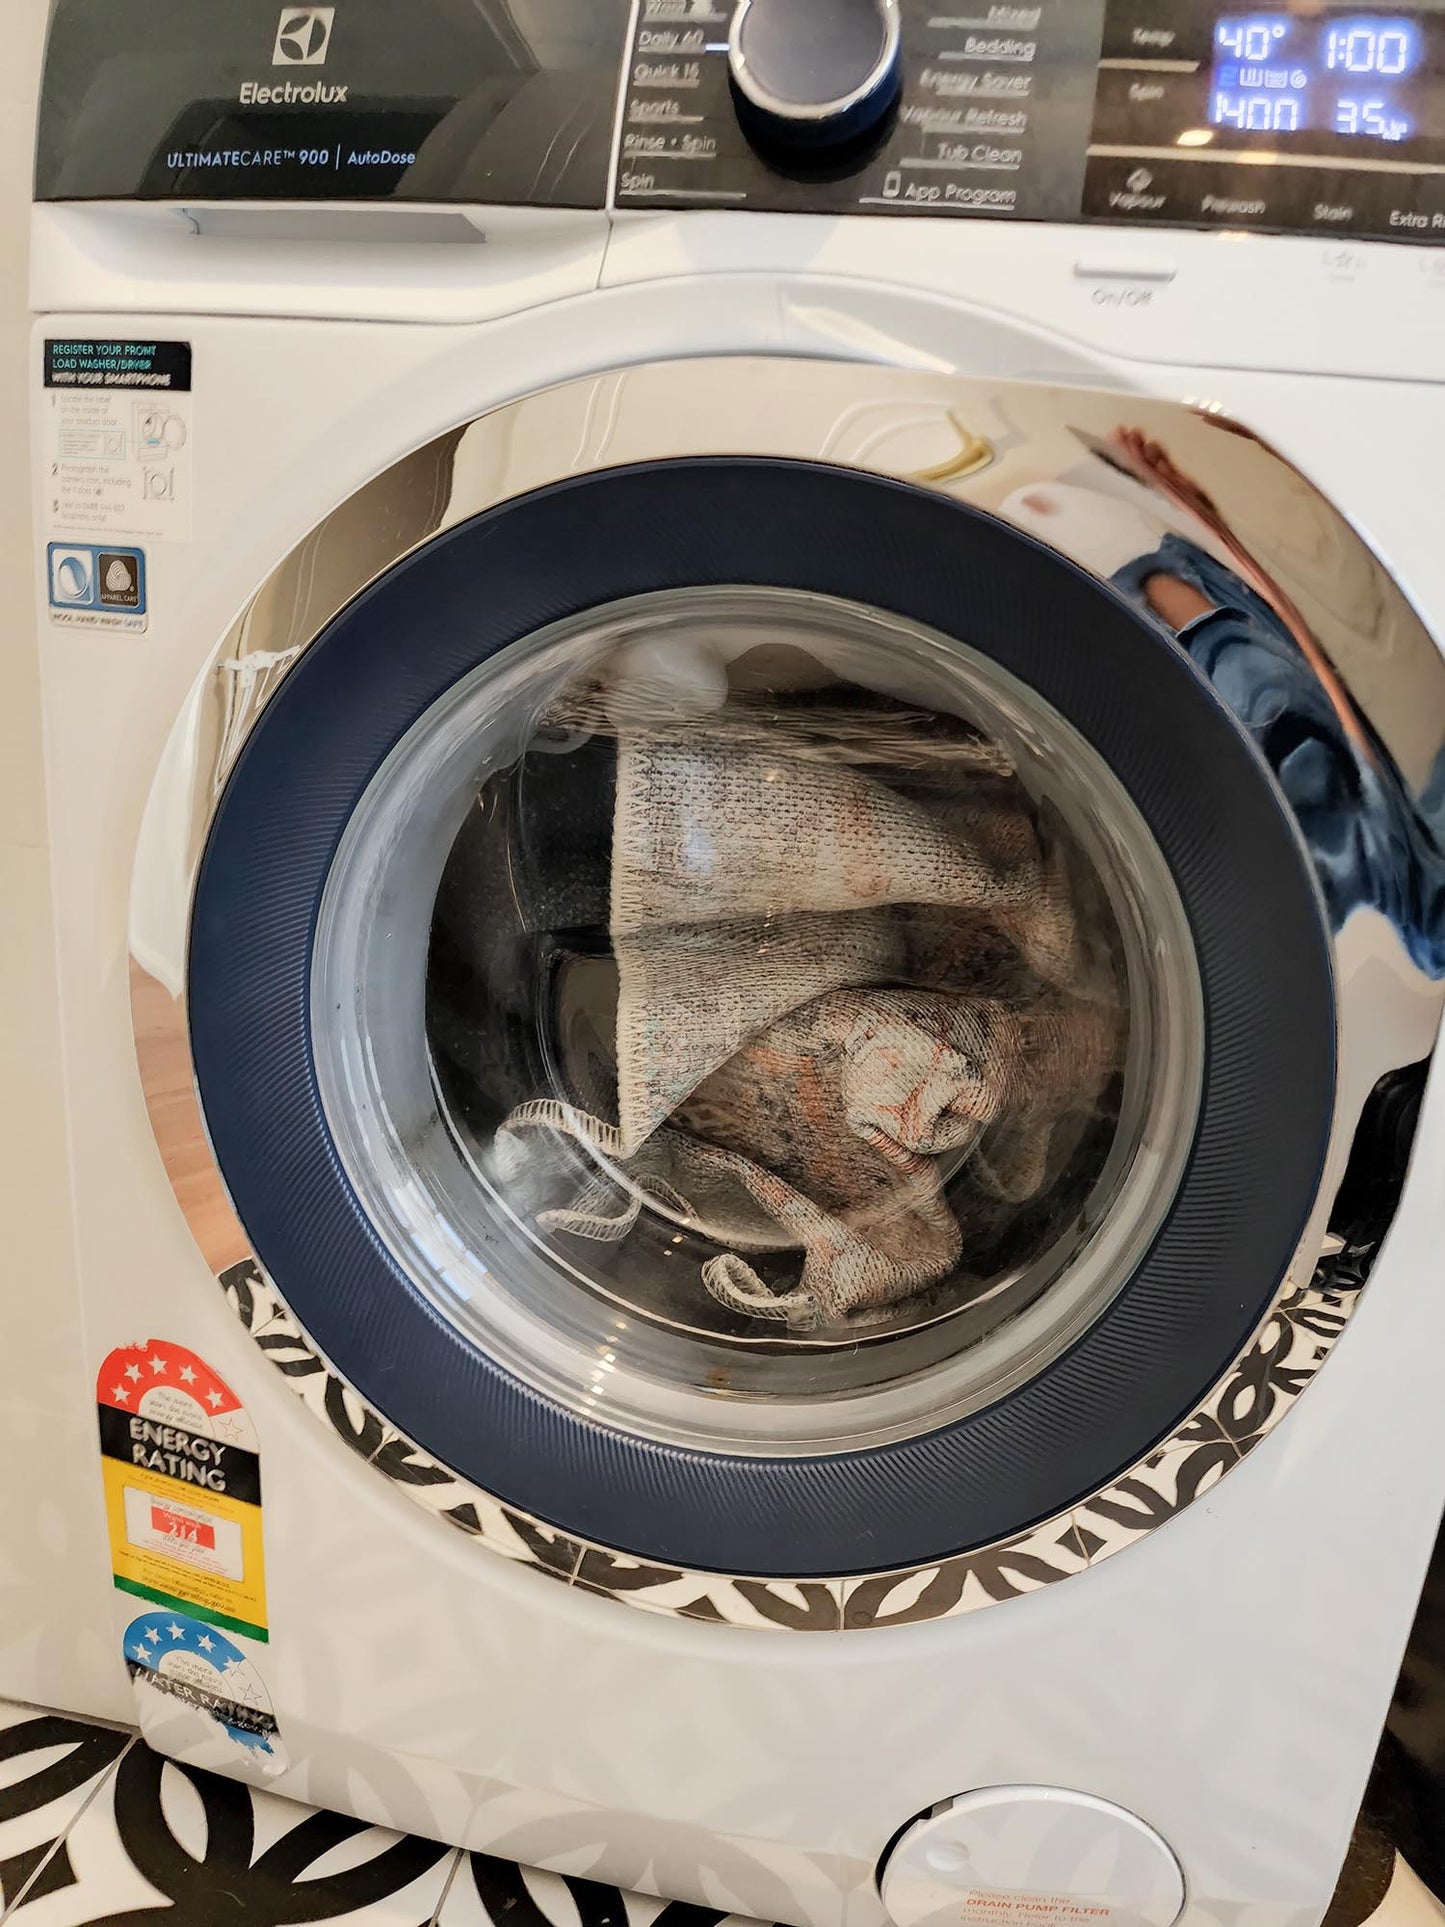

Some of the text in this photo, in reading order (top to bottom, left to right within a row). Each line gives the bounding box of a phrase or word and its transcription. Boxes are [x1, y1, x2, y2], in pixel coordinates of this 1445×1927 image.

[639, 30, 679, 49] Daily
[964, 36, 1036, 57] Bedding
[1326, 30, 1407, 74] 1:00
[634, 63, 679, 80] Quick
[981, 71, 1032, 89] Saver
[239, 80, 349, 104] Electrolux
[630, 100, 679, 117] Sports
[965, 107, 1028, 126] Refresh
[1215, 92, 1298, 131] 1400
[624, 133, 665, 150] Rinse
[682, 134, 716, 154] Spin
[938, 142, 1022, 163] Tub Clean
[299, 150, 329, 165] 900
[347, 150, 416, 165] AutoDose
[621, 171, 655, 192] Spin
[905, 182, 1017, 205] App Program
[1314, 203, 1352, 220] Stain
[1390, 209, 1428, 228] Extra
[53, 345, 156, 356] REGISTER YOUR FRONT
[53, 359, 77, 369] LOAD
[104, 372, 171, 386] SMARTPHONE
[101, 593, 124, 601] APPAREL
[129, 1417, 227, 1467] ENERGY
[132, 1443, 226, 1493] RATING
[966, 1898, 1110, 1916] DRAIN PUMP FILTER
